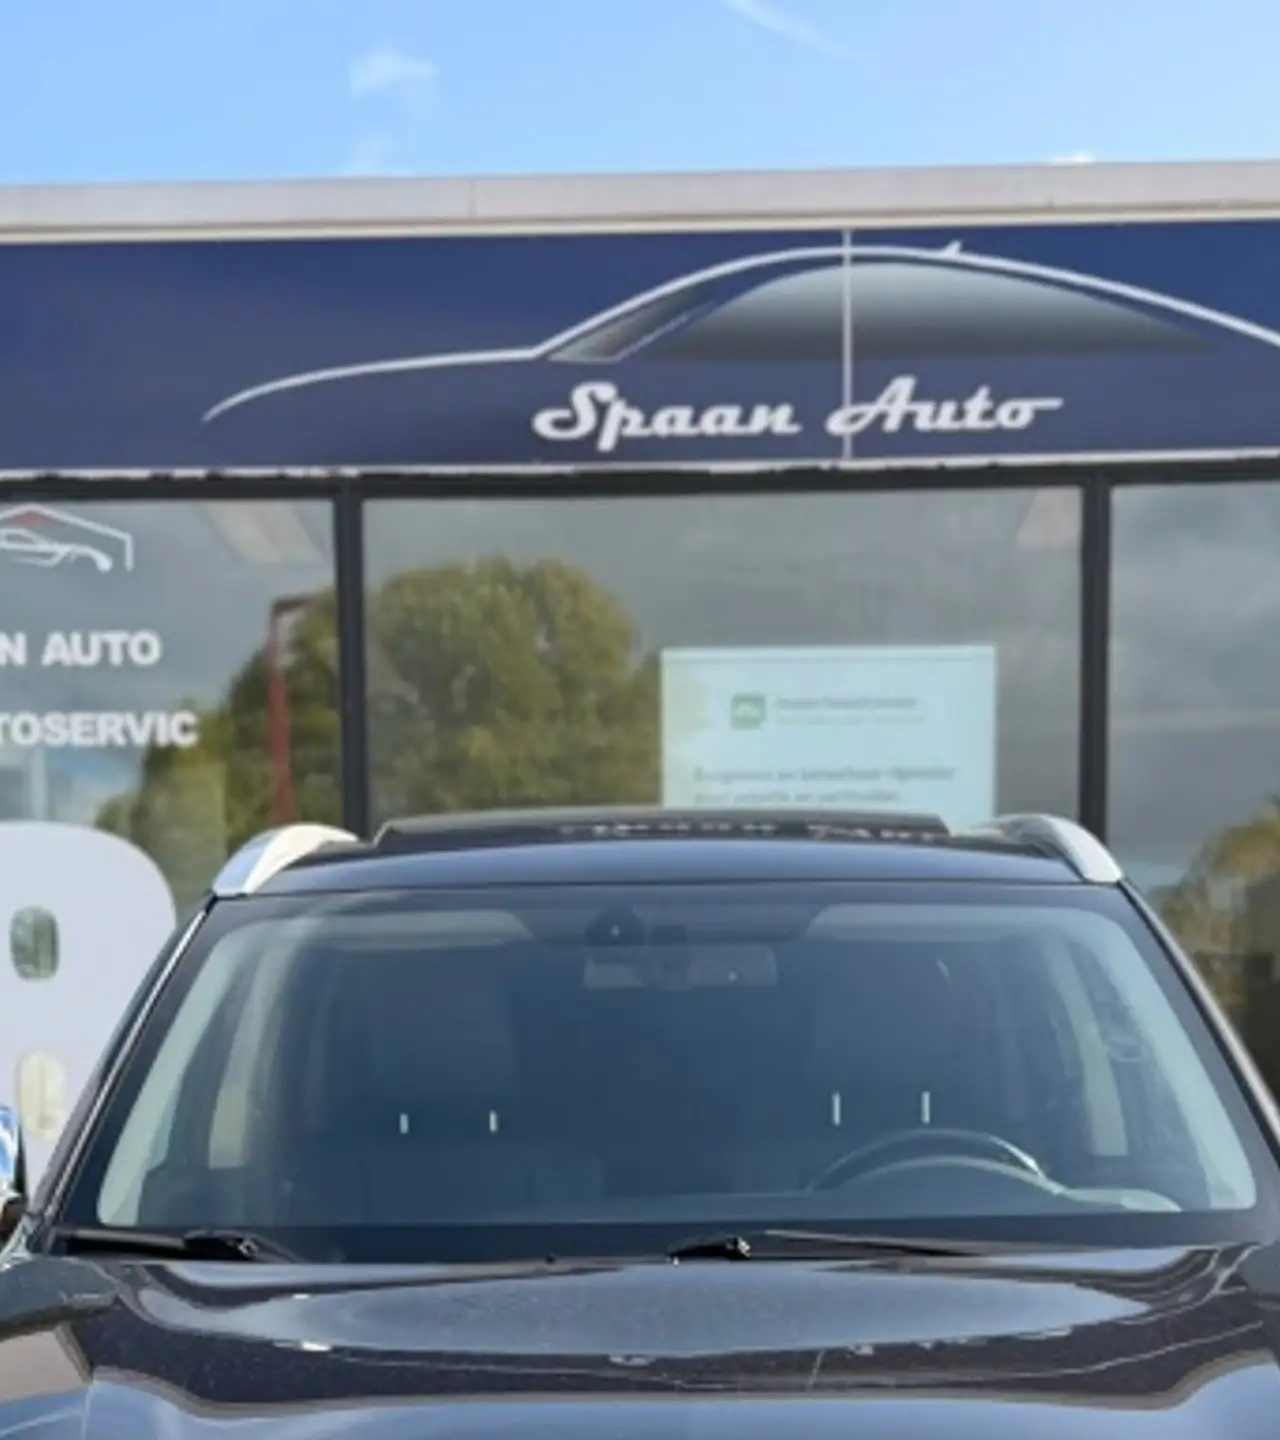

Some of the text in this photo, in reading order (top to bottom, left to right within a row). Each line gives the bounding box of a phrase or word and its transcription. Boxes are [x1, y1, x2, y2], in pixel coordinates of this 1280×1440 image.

[532, 375, 1064, 452] Spaan Auto
[41, 630, 162, 666] AUTO
